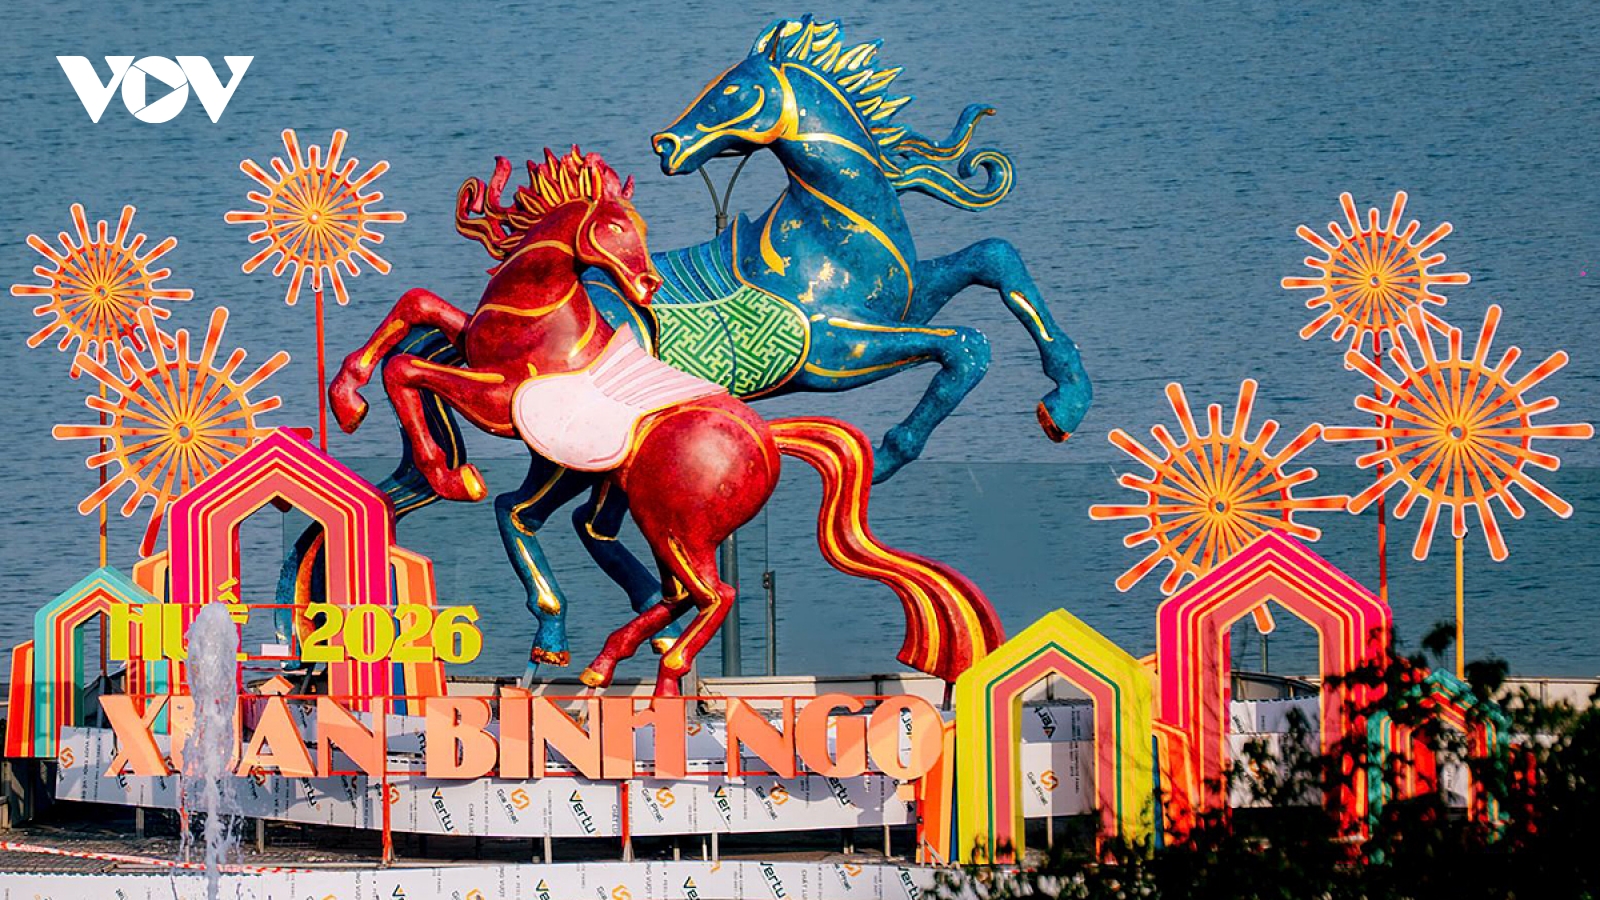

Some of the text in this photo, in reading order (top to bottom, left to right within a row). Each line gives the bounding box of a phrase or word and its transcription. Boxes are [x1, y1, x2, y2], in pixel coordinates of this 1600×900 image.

[302, 602, 483, 664] 2026
[726, 693, 944, 802] NGỌ
[431, 786, 454, 832] Vertu
[569, 790, 596, 834] Vertu
[828, 777, 851, 806] ertu
